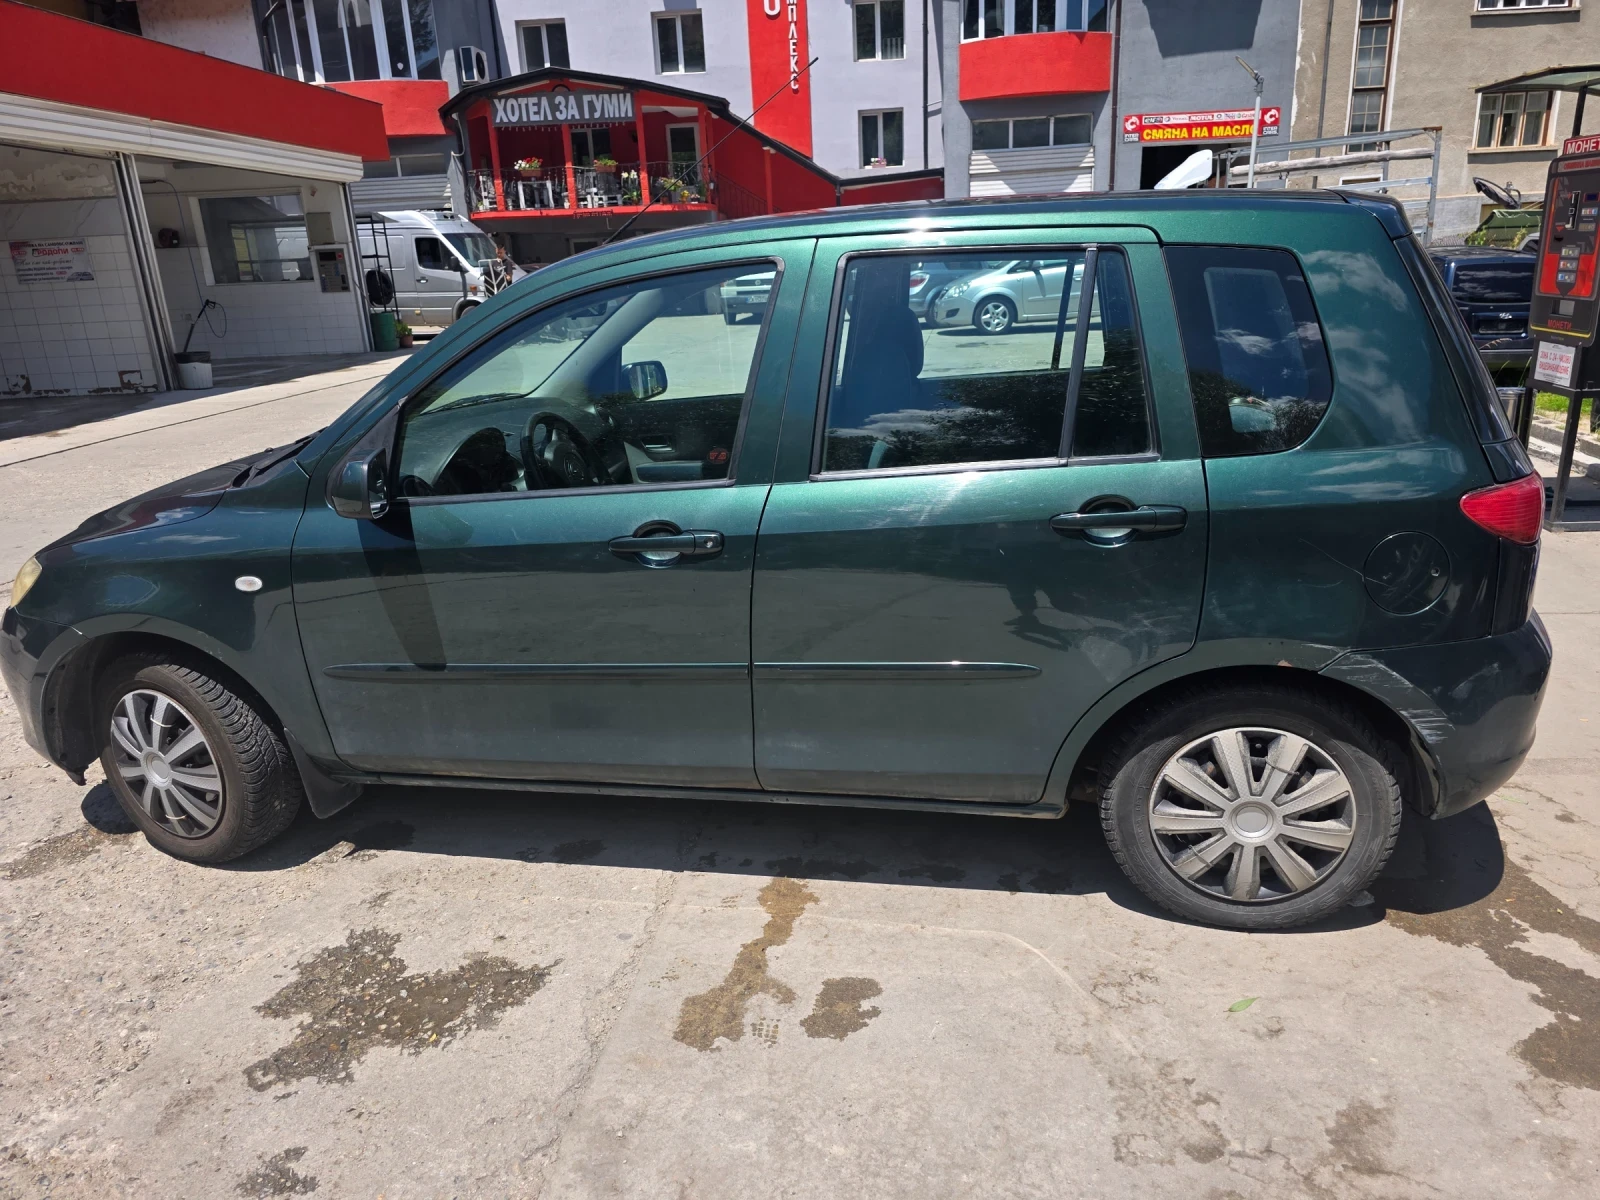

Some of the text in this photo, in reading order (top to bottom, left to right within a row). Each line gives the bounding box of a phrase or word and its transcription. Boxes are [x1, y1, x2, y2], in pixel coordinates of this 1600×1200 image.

[786, 0, 799, 90] ПЛЕКС
[493, 93, 633, 123] ХОТЕЛ ЗА ГУМИ
[1143, 128, 1188, 140] СМЯНА
[1192, 125, 1210, 138] НА
[37, 247, 69, 257] РОДОПИ
[1547, 319, 1572, 331] МОНЕТИ
